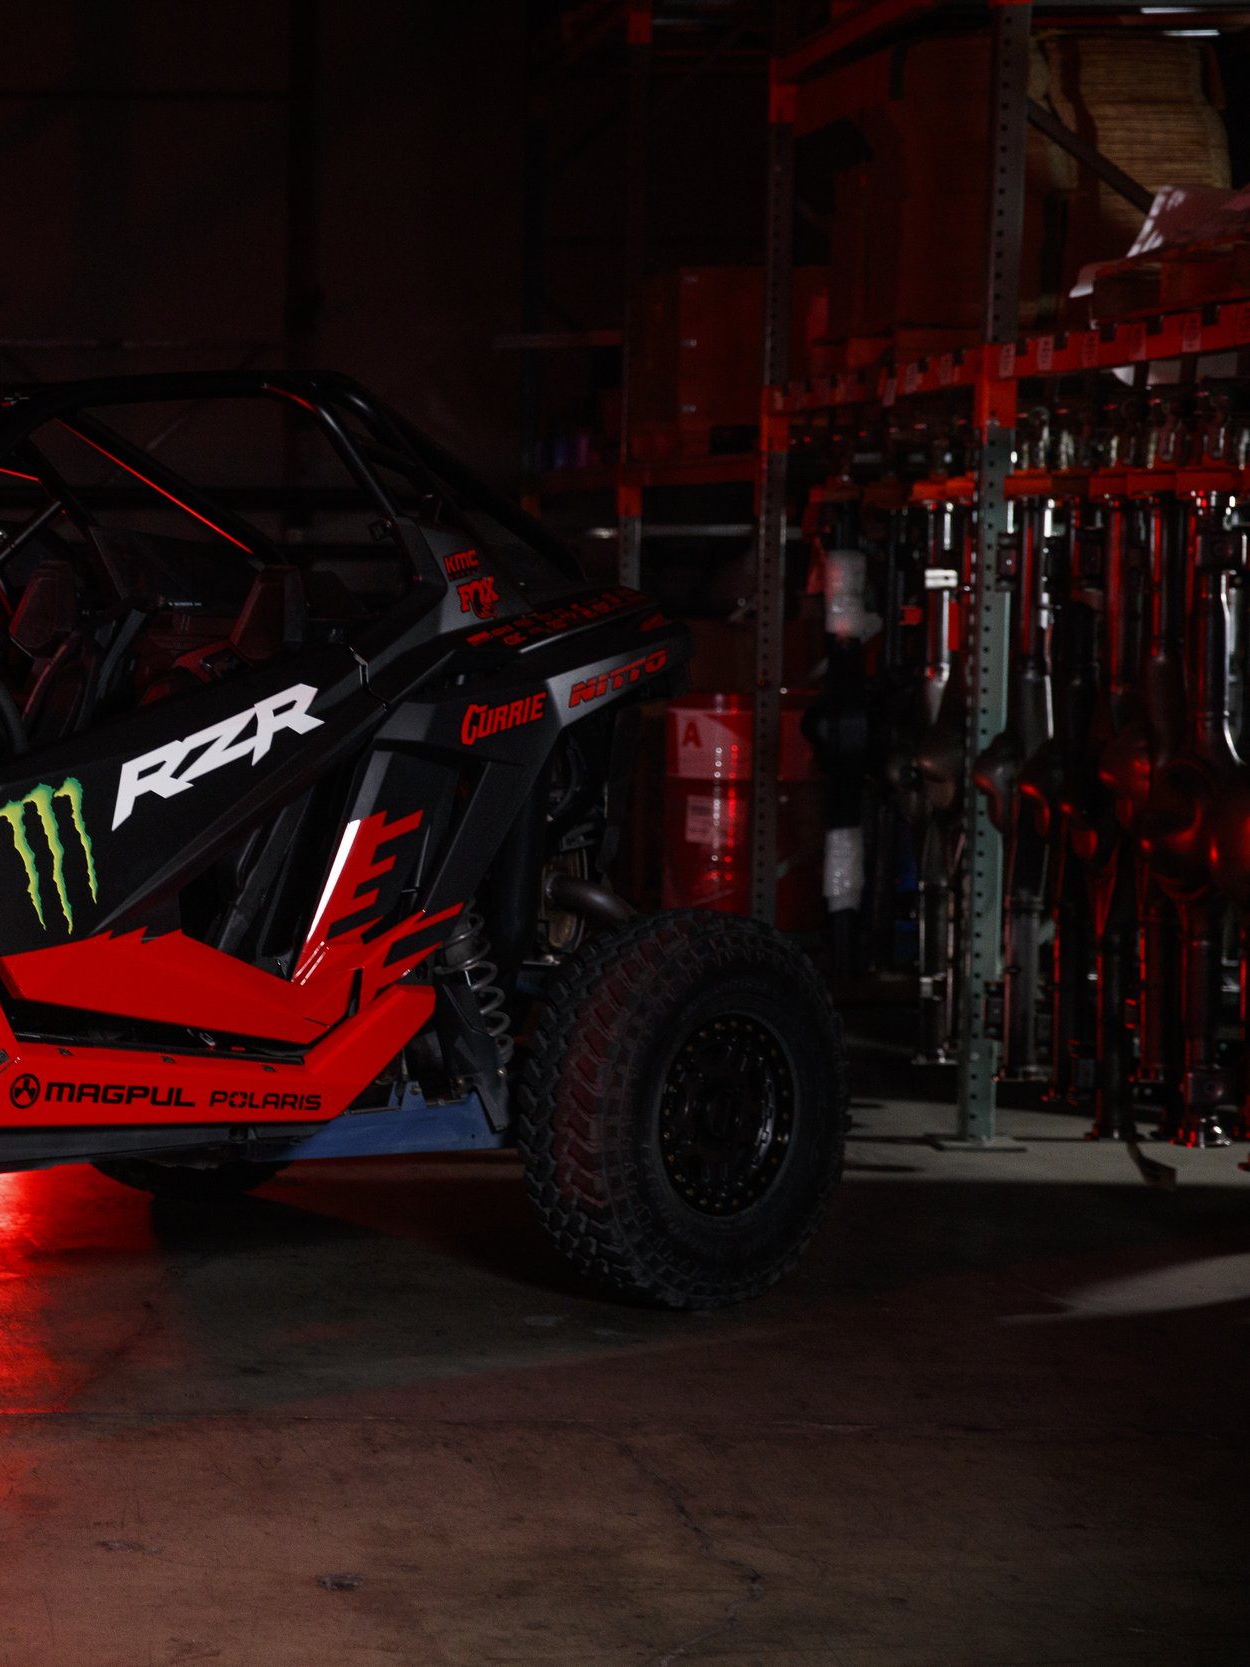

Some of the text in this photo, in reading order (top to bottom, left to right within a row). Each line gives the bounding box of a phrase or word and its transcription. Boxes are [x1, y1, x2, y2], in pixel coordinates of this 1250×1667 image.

[457, 575, 500, 618] FOX
[569, 649, 669, 708] NITTO
[683, 722, 701, 746] A
[111, 683, 325, 832] RZR
[45, 1081, 322, 1111] MAGPUL POLARIS
